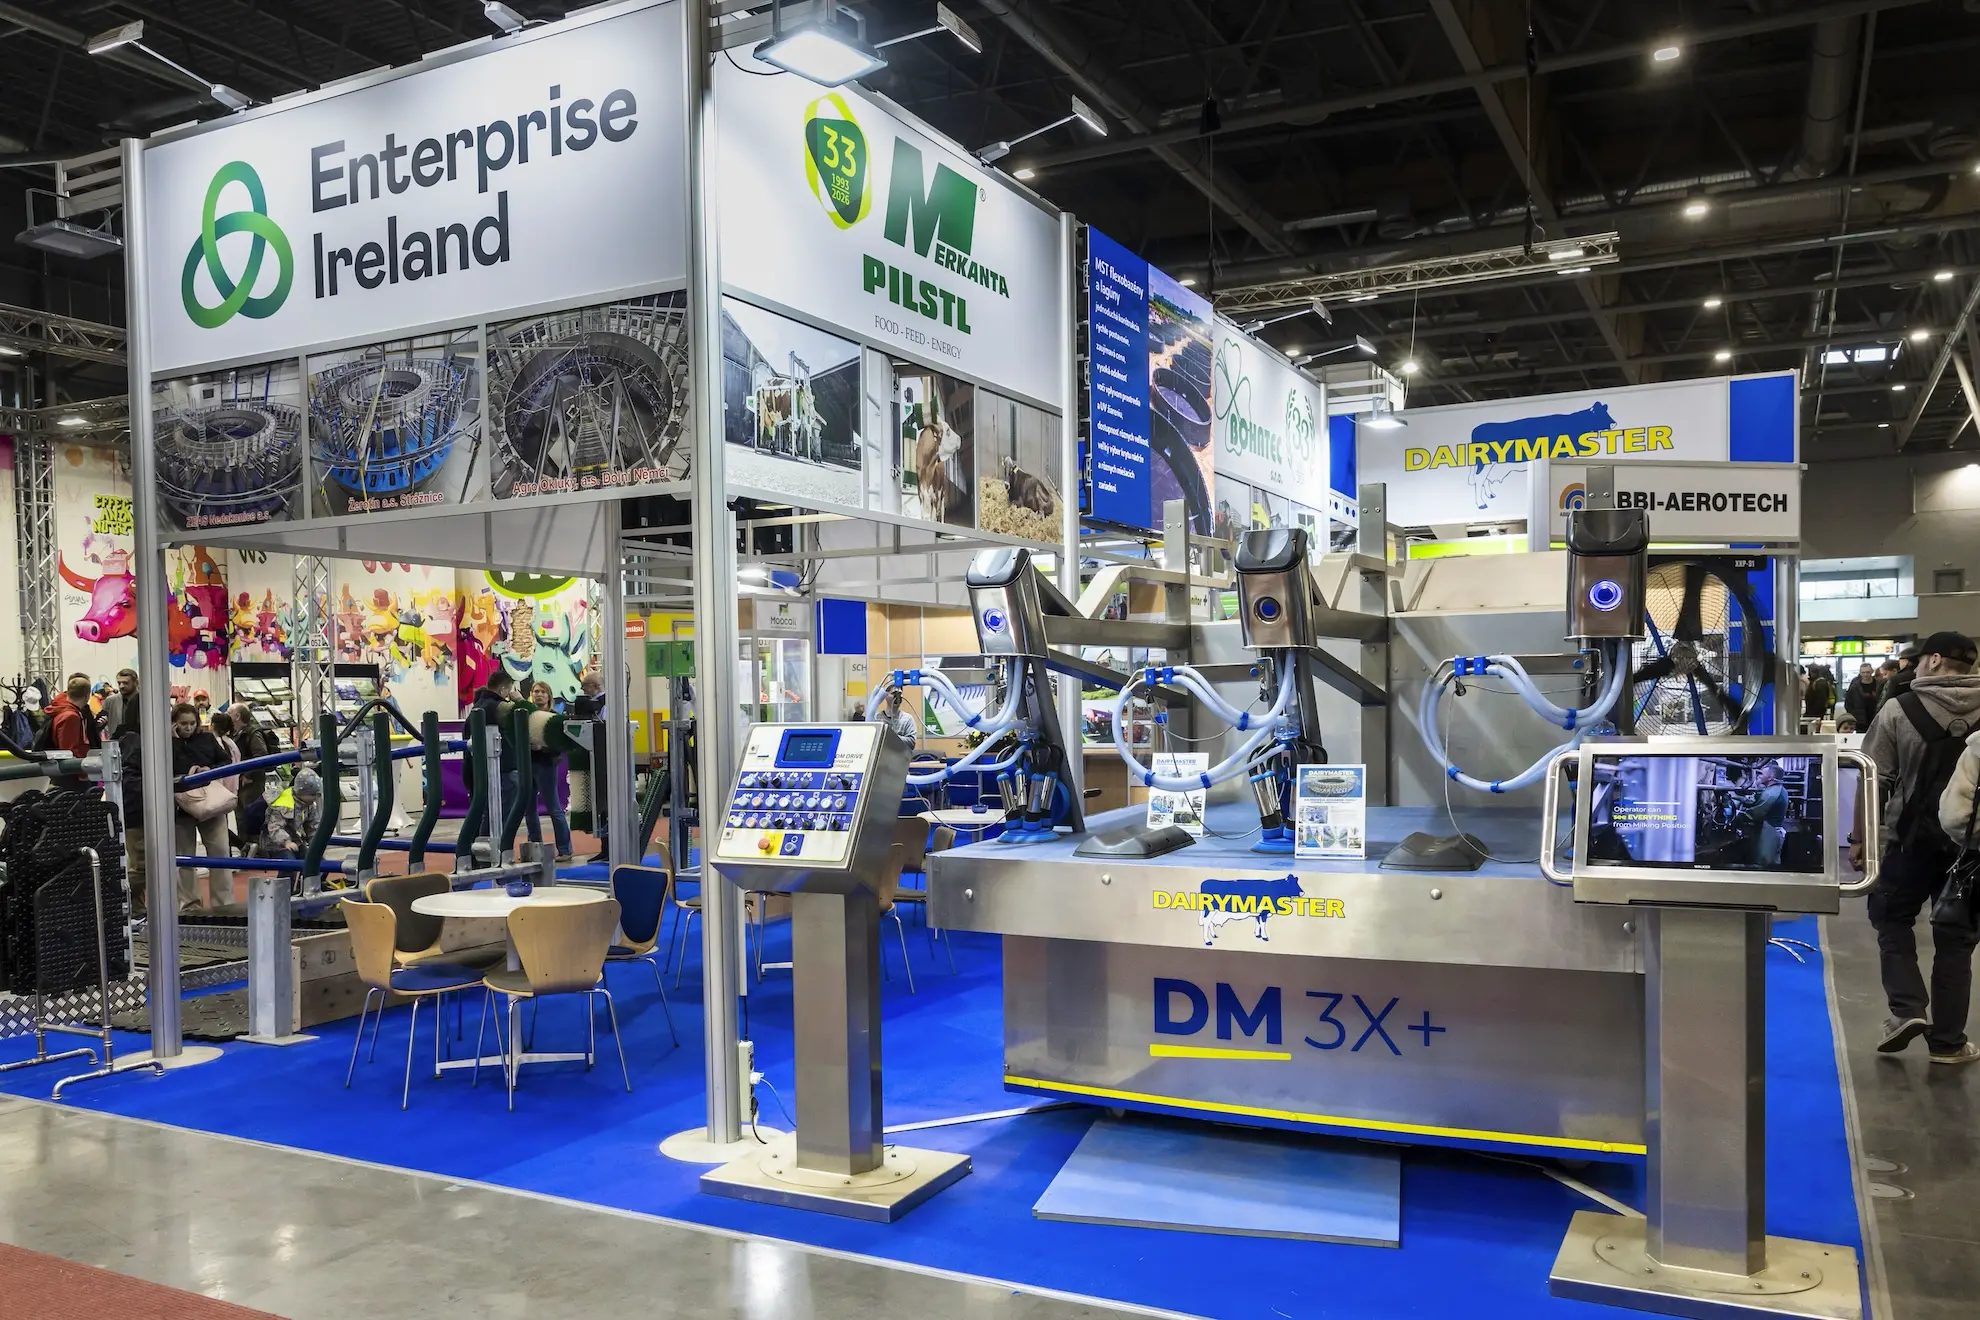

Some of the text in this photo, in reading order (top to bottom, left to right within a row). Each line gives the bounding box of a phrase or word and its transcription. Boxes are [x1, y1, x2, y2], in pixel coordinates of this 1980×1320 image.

[311, 84, 638, 213] Enterprise
[823, 125, 856, 177] 33
[831, 173, 850, 190] 1993
[831, 187, 850, 205] 2026
[313, 190, 510, 299] Ireland
[1095, 256, 1109, 277] MST
[863, 253, 971, 335] PILSTL
[874, 314, 899, 336] FOOD
[905, 326, 926, 346] FEED
[931, 336, 962, 360] ENERGY
[1405, 425, 1674, 471] DAIRYMASTER
[512, 481, 537, 496] Agro
[1614, 491, 1788, 513] BBI-AEROTECH
[1152, 889, 1346, 918] DAIRYMASTER
[1153, 977, 1446, 1056] DM 3X+
